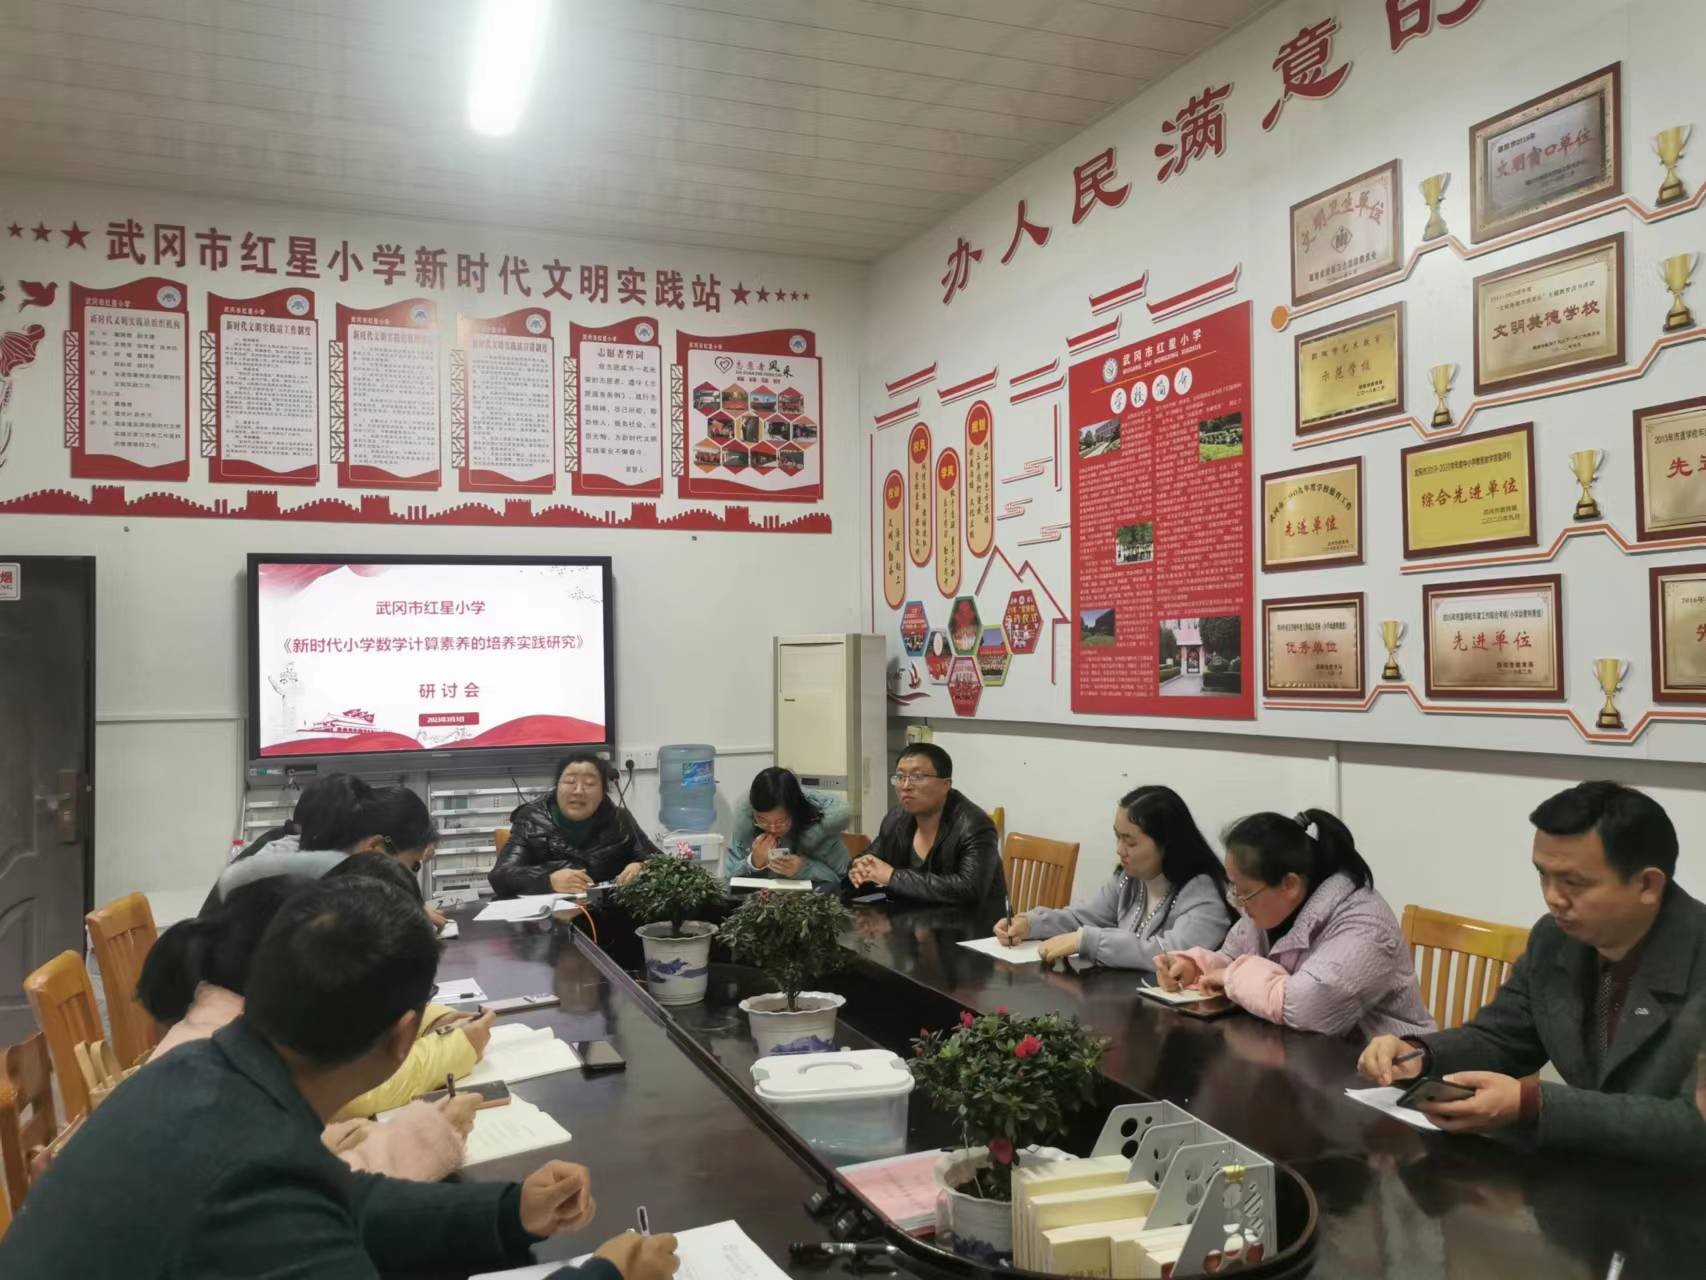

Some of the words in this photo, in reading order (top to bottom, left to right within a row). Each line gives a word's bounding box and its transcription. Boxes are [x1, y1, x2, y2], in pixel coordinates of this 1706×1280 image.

[105, 219, 721, 313] 武冈市红星小学新时代文明实践站
[226, 320, 312, 337] 新时代文明实践站工作制度
[598, 347, 644, 361] 志愿者誓词
[1122, 328, 1202, 366] 武冈市红星小学
[1422, 477, 1519, 508] 综合先进单位
[1285, 514, 1339, 537] 先进单位
[375, 600, 486, 616] 武冈市红星小学
[281, 634, 584, 654] 《新时代小学数学计算素养的培养实践研究》
[1286, 641, 1338, 655] 优秀单位
[1452, 630, 1532, 652] 先进单位
[419, 682, 480, 699] 研讨会
